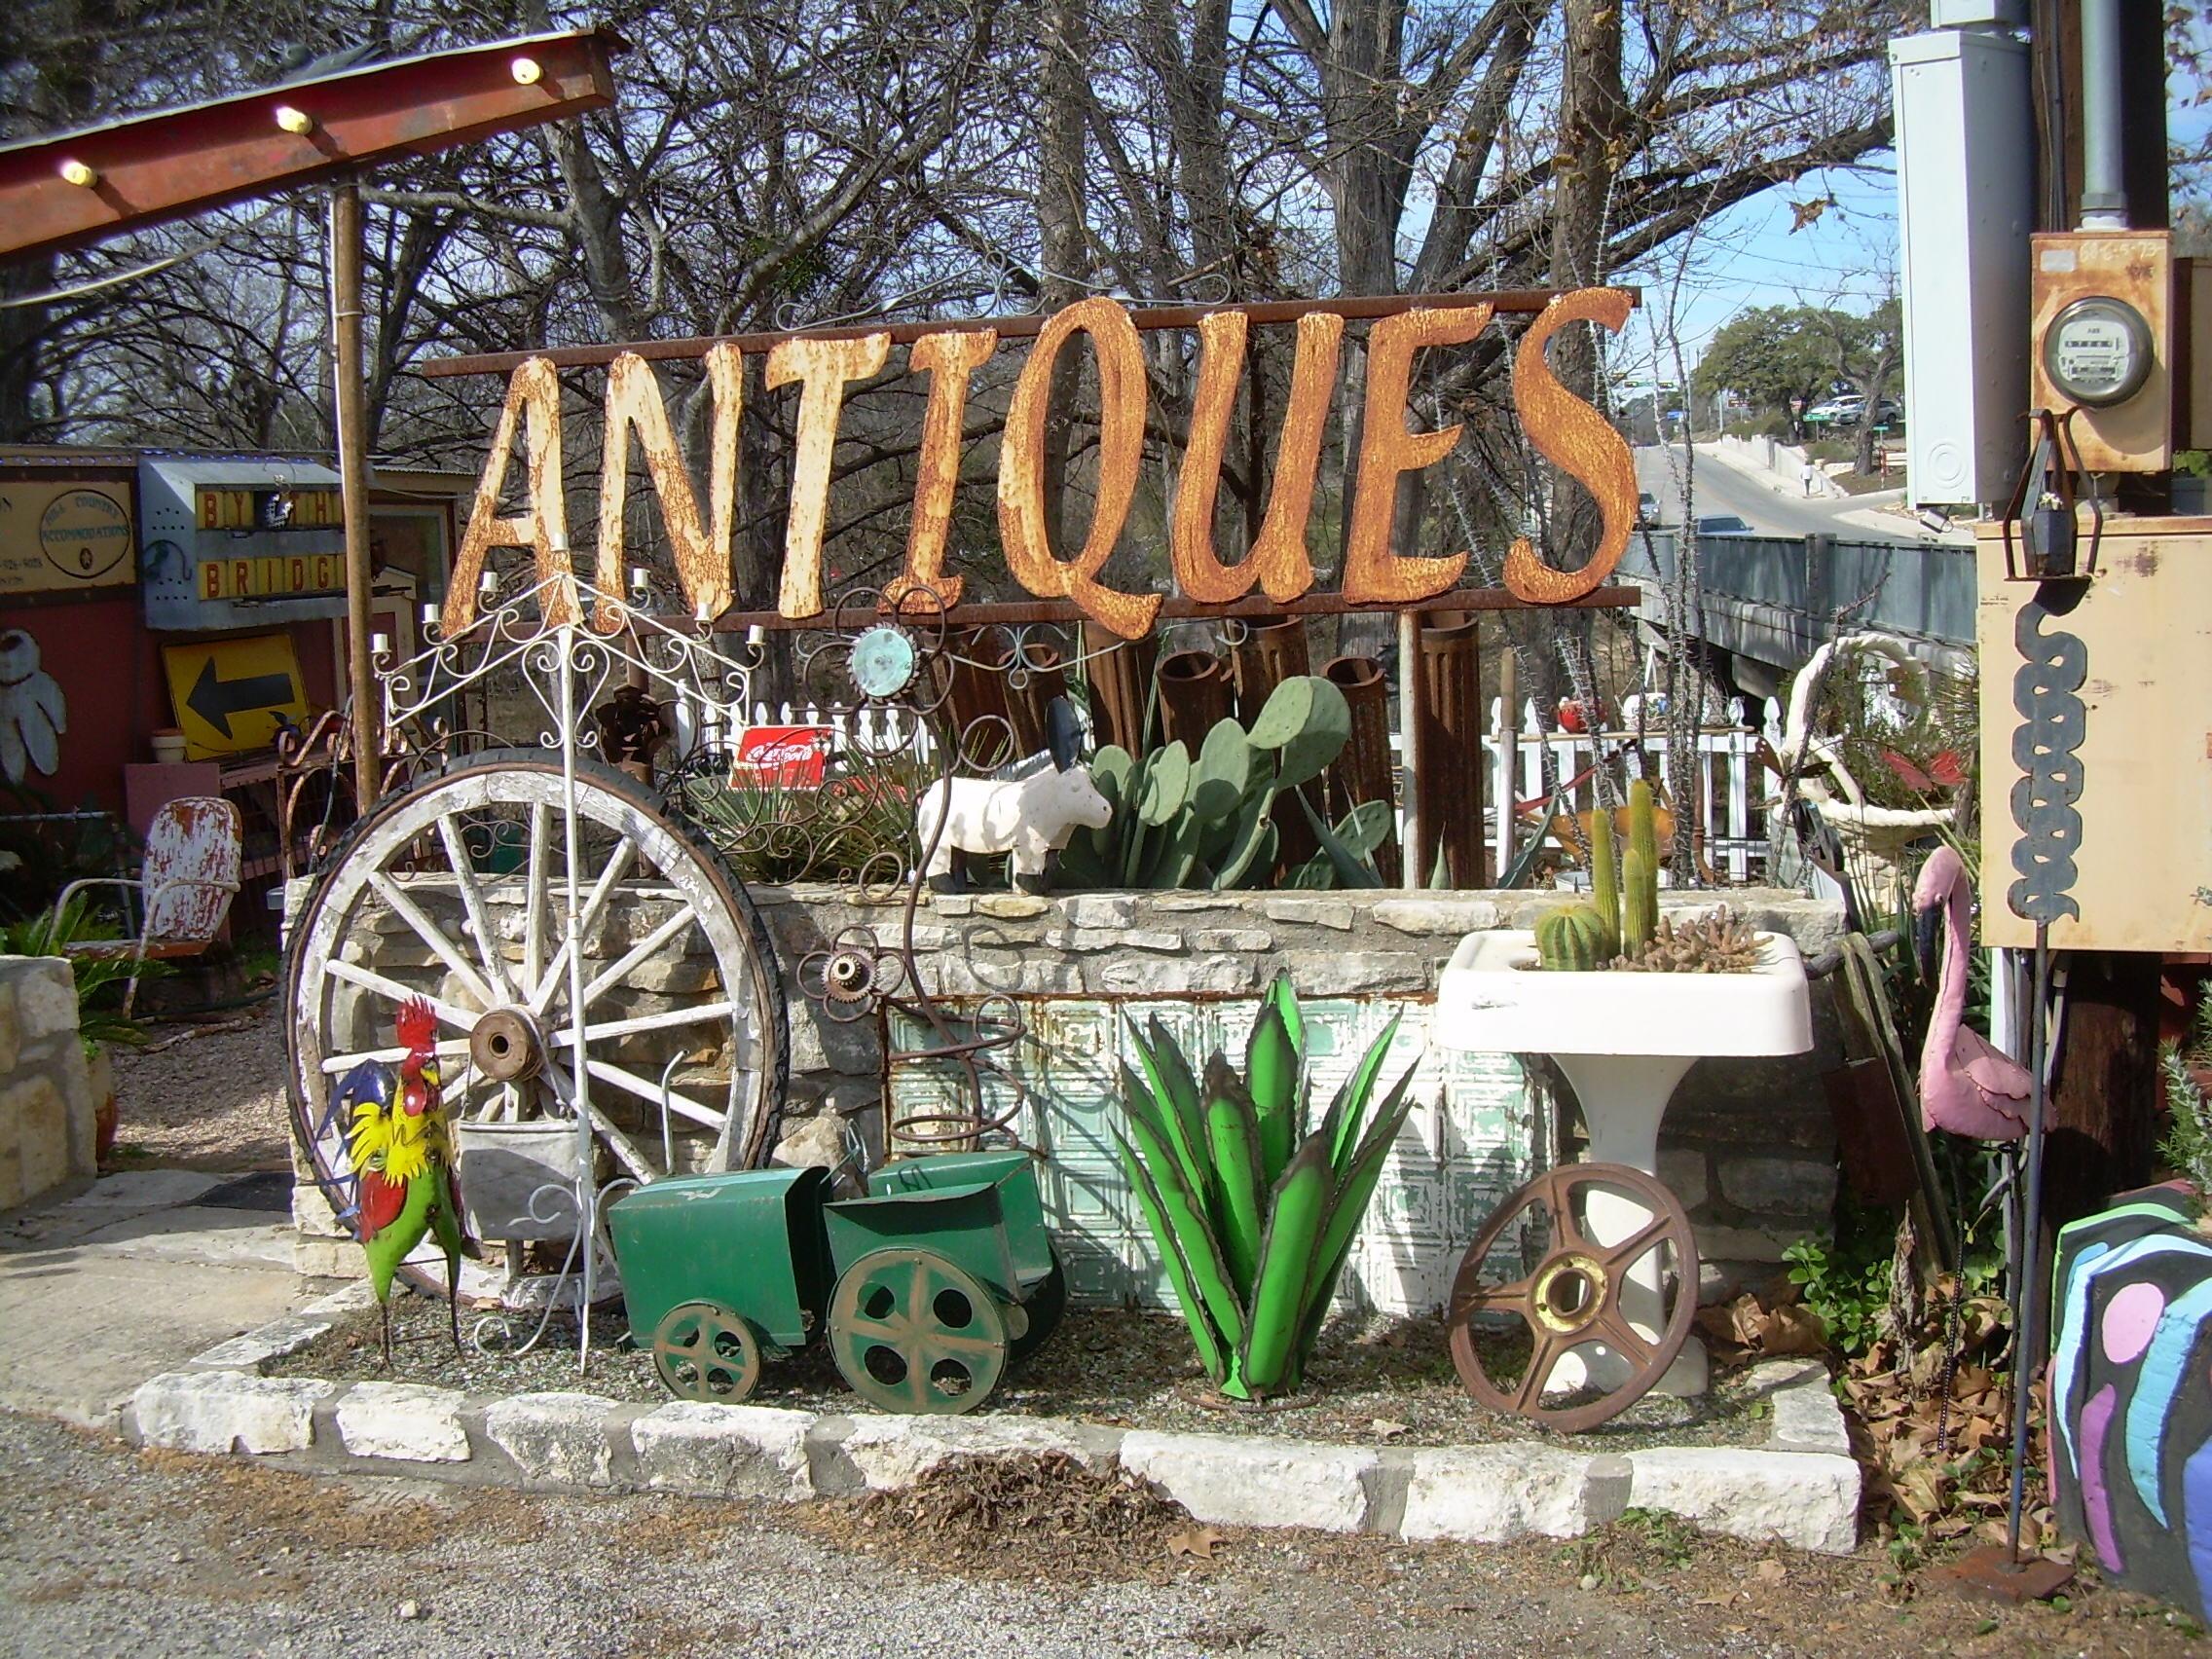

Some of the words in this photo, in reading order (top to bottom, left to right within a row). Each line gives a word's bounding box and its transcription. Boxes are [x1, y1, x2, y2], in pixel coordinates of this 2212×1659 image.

[439, 285, 1639, 641] ANTIQUES
[75, 497, 120, 520] COUNTRY
[204, 491, 244, 528] BY
[289, 490, 346, 527] TH
[206, 555, 349, 598] BRIDG
